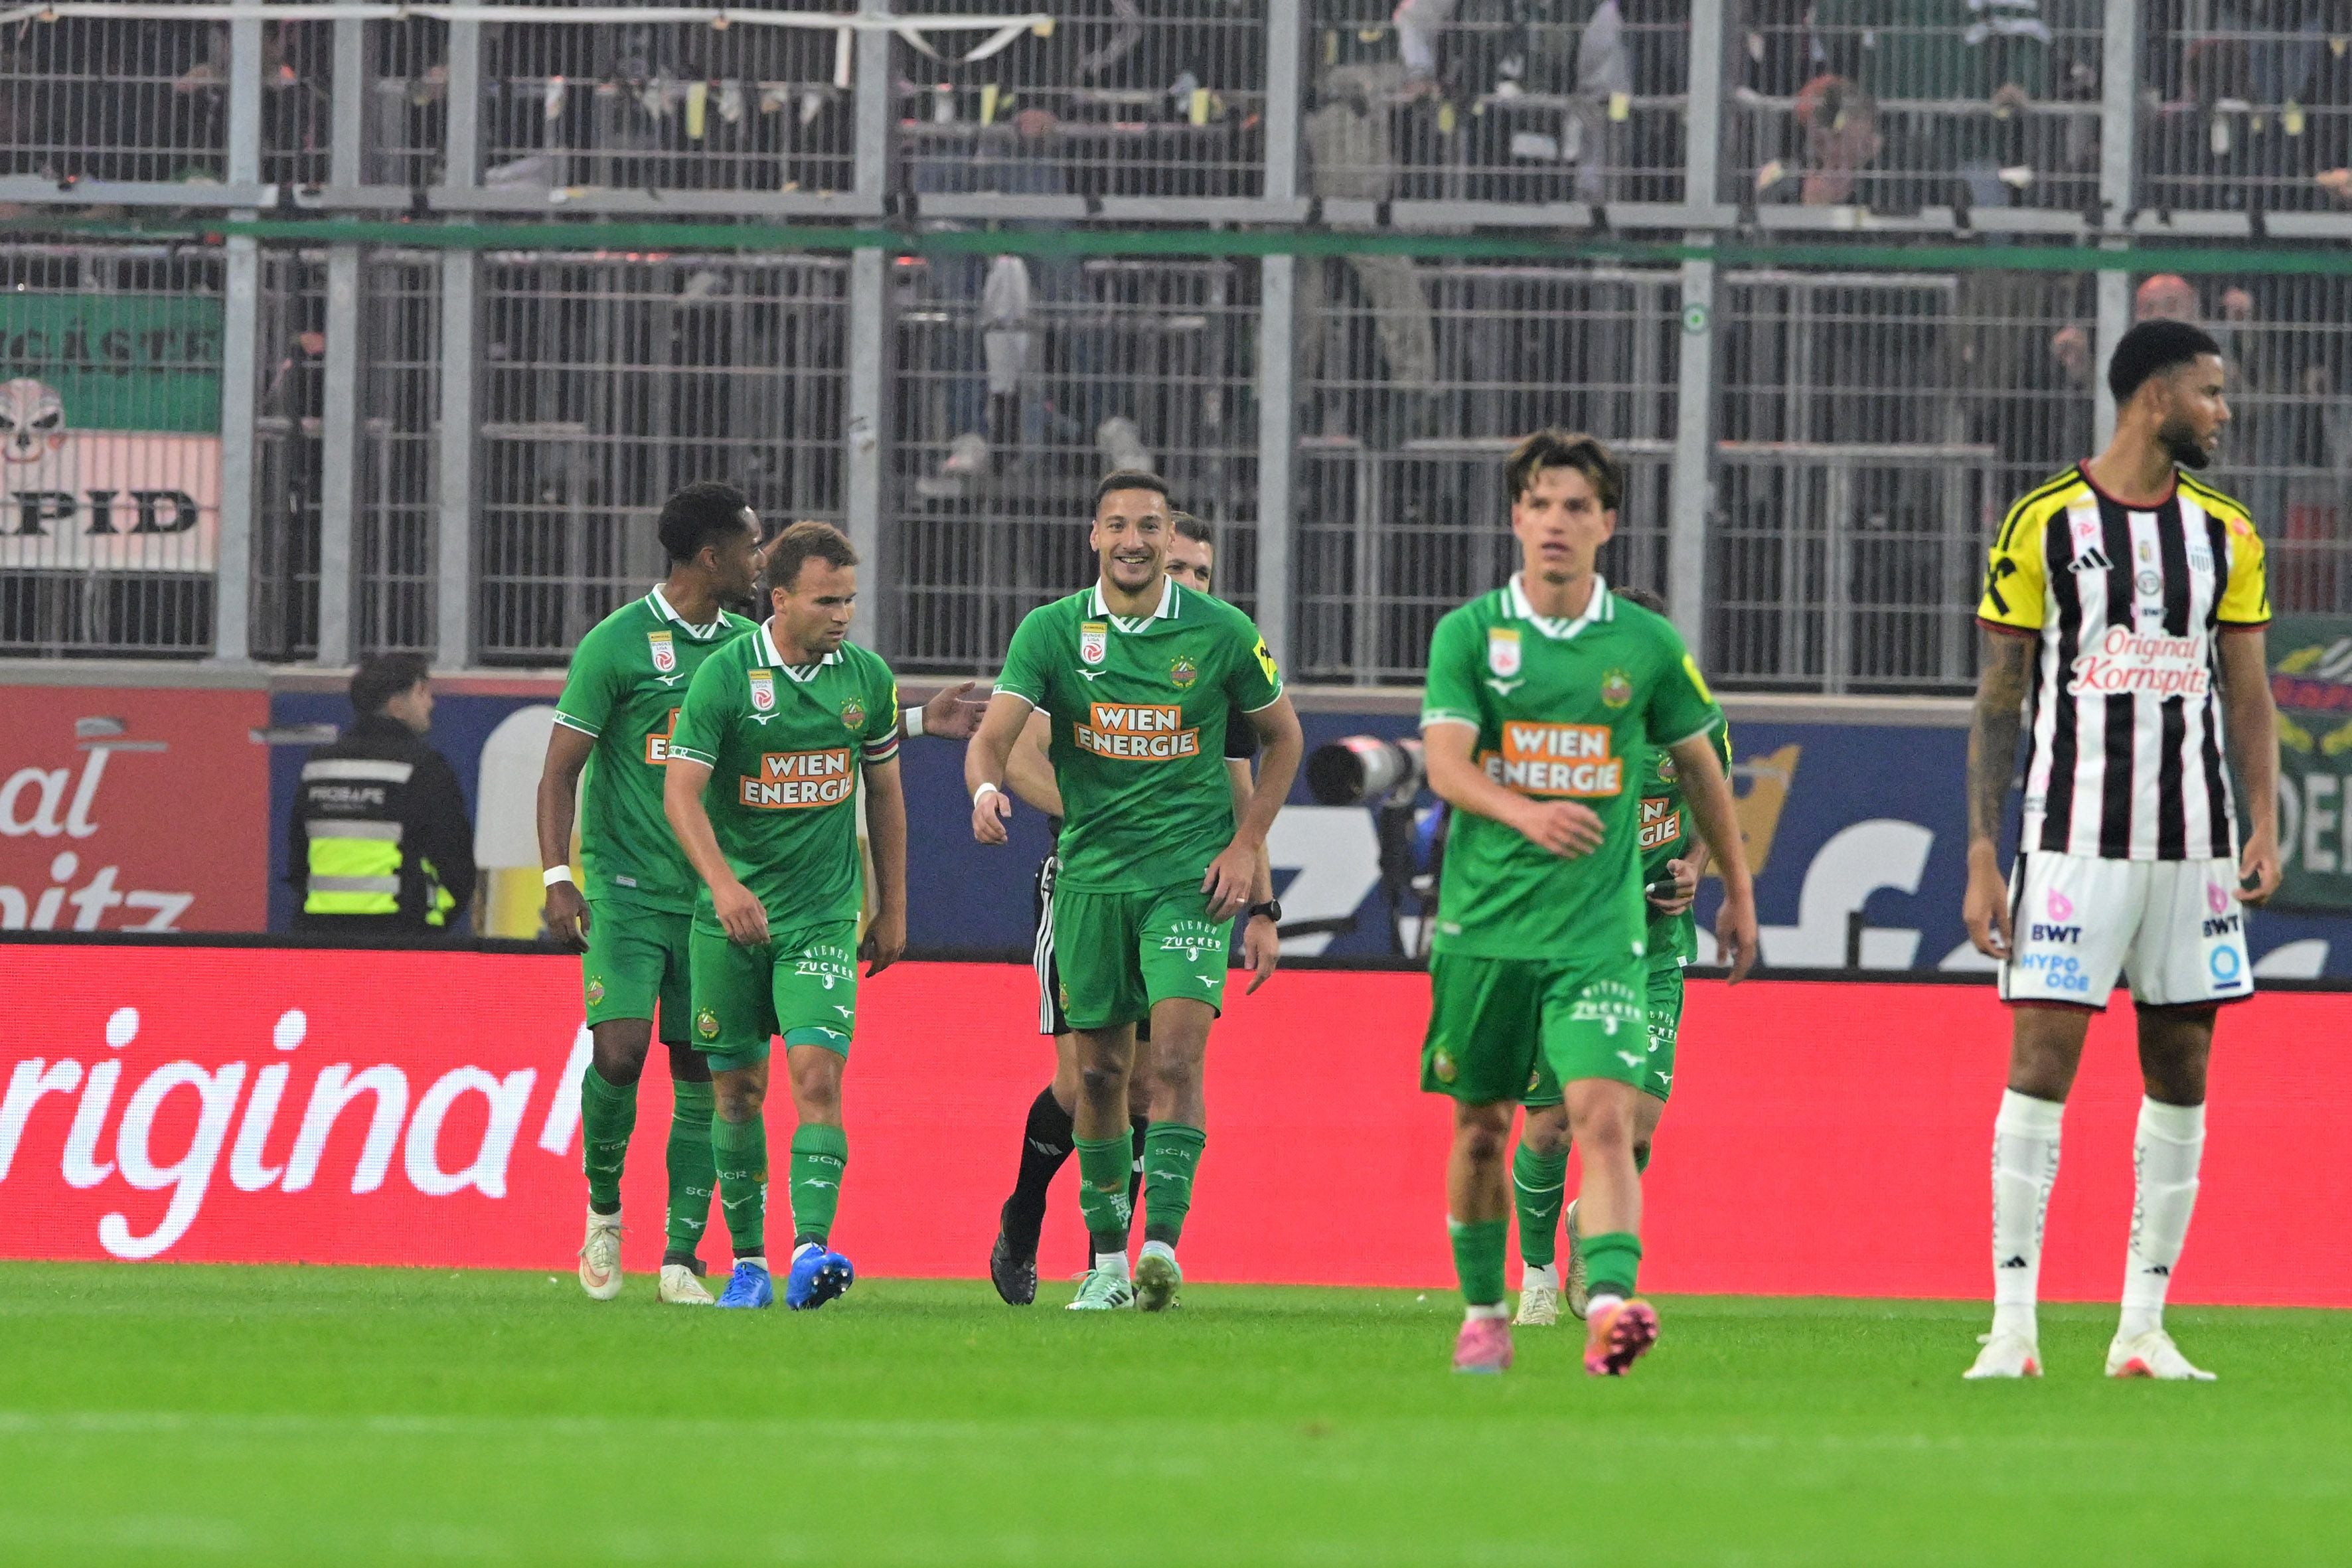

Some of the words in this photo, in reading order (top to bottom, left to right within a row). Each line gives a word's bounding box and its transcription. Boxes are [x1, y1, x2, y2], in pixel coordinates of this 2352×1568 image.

[0, 490, 199, 535] PID
[2104, 629, 2201, 665] Original
[2071, 655, 2205, 695] Kornspitz
[1095, 706, 1177, 731] WIEN
[1077, 726, 1195, 758] ENERGIE
[1510, 726, 1605, 758] WIEN
[766, 752, 846, 778] WIEN
[1485, 755, 1618, 791] ENERGIE
[744, 775, 851, 805] ENERGIE
[1170, 920, 1217, 935] WIENER
[2031, 923, 2082, 944] BWT
[2203, 914, 2239, 938] BWT
[803, 945, 850, 963] WIENER
[1160, 936, 1221, 952] ZUCKER
[795, 961, 855, 982] ZUCKER
[2021, 954, 2079, 973] HYPO
[808, 1155, 842, 1170] SCR
[1155, 1148, 1190, 1161] SCR
[716, 1169, 747, 1180] SCR
